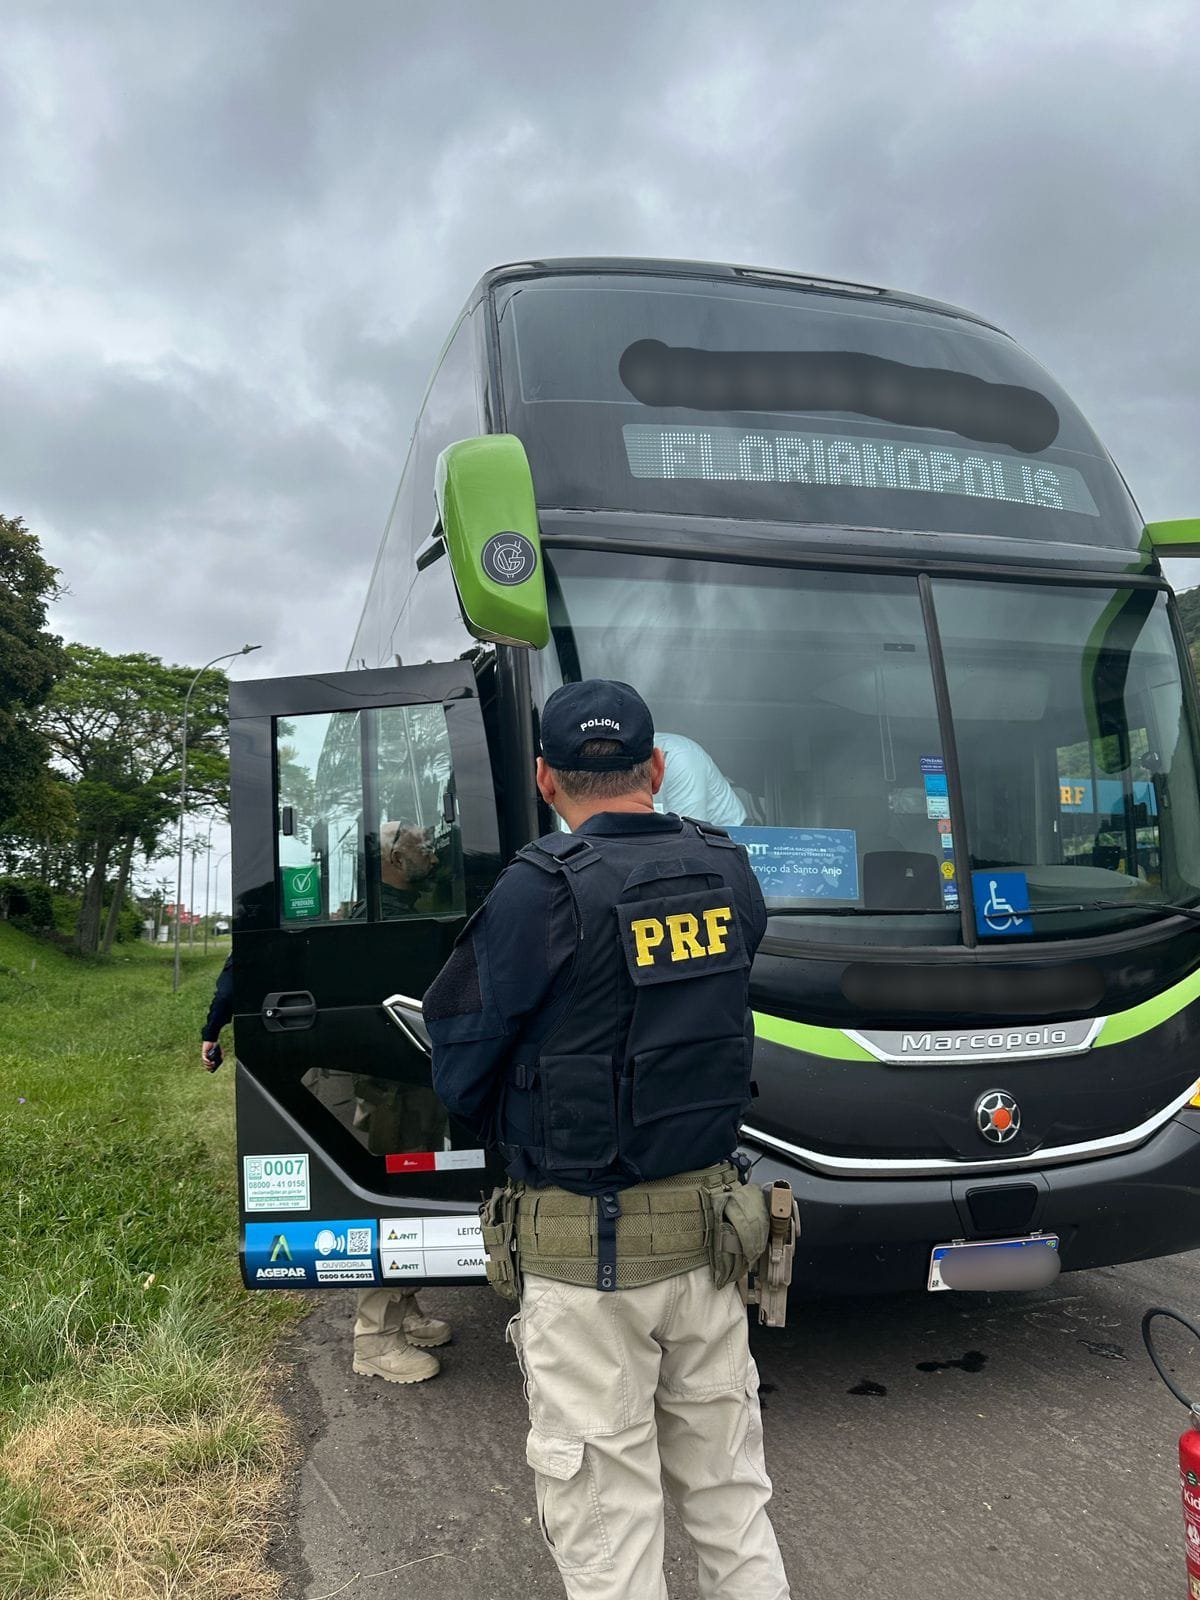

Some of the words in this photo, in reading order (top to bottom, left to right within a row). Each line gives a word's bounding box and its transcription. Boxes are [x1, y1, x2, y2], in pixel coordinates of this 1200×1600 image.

[660, 432, 1064, 510] FLORIANOPOLIS
[1060, 786, 1086, 805] RF
[746, 843, 769, 855] NTT
[780, 864, 790, 873] da
[793, 864, 819, 874] Santo
[821, 865, 843, 877] Anjo
[631, 907, 732, 967] PRF
[901, 1026, 1067, 1052] Marcopolo
[264, 1160, 304, 1176] 0007
[399, 1233, 418, 1241] ANTT
[457, 1227, 481, 1236] LEITO
[321, 1261, 366, 1269] OUVIDORIA
[400, 1263, 419, 1271] ANTT
[457, 1258, 484, 1267] CAMA
[256, 1267, 307, 1278] AGEPAR
[1183, 1487, 1200, 1511] Kid
